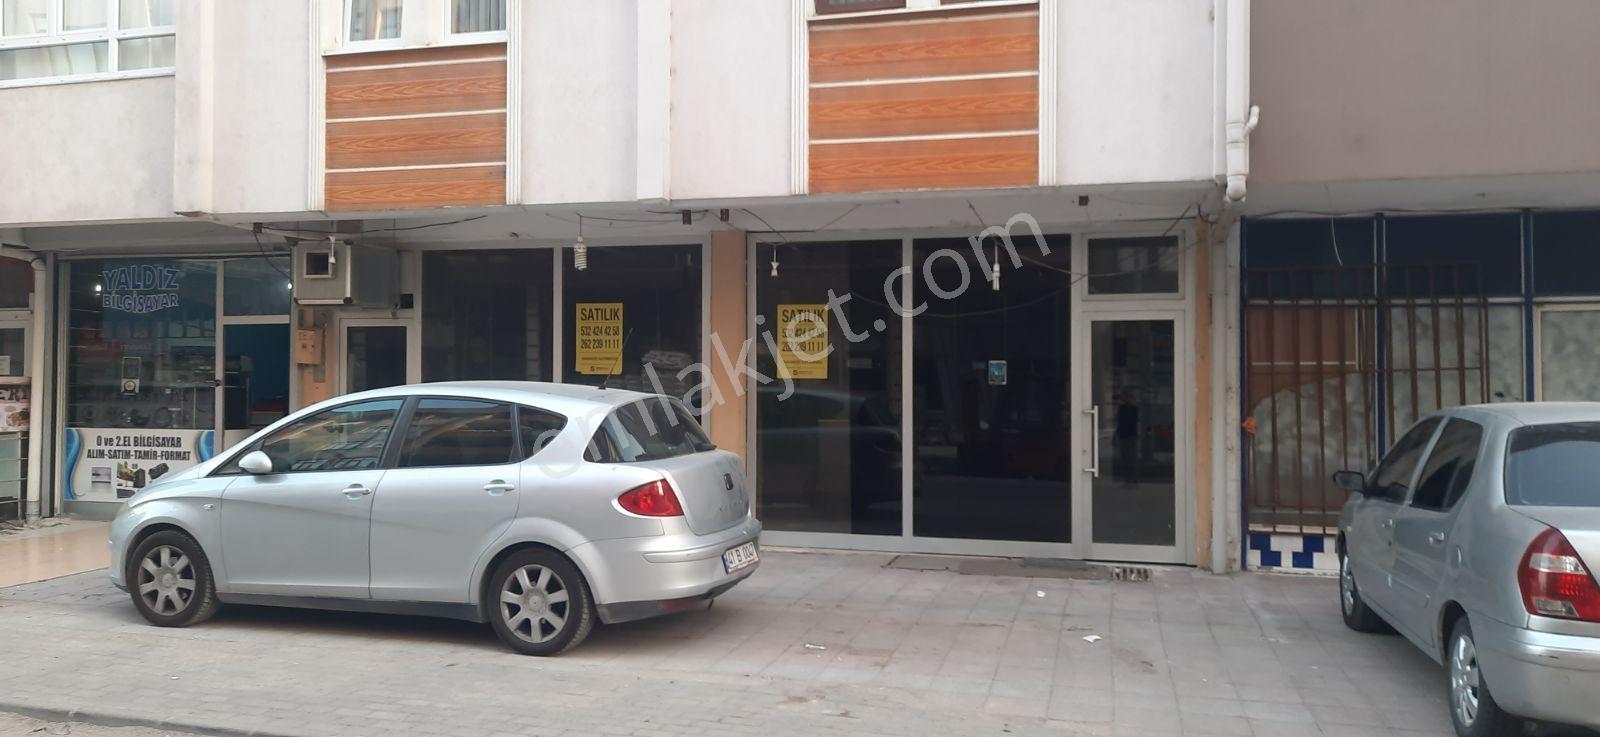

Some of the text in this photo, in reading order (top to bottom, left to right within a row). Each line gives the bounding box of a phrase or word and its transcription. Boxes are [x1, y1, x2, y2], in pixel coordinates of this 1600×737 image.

[102, 291, 179, 313] BİLGİSAYAR
[581, 307, 620, 321] SATILIK
[782, 309, 824, 323] SATILIK
[581, 326, 592, 336] 532
[604, 339, 611, 349] 11
[613, 339, 619, 349] 11
[808, 341, 815, 352] 11
[817, 341, 824, 352] 11
[104, 438, 113, 447] ve
[116, 435, 131, 447] 2.EL
[133, 434, 182, 448] BİLGİSAYAR
